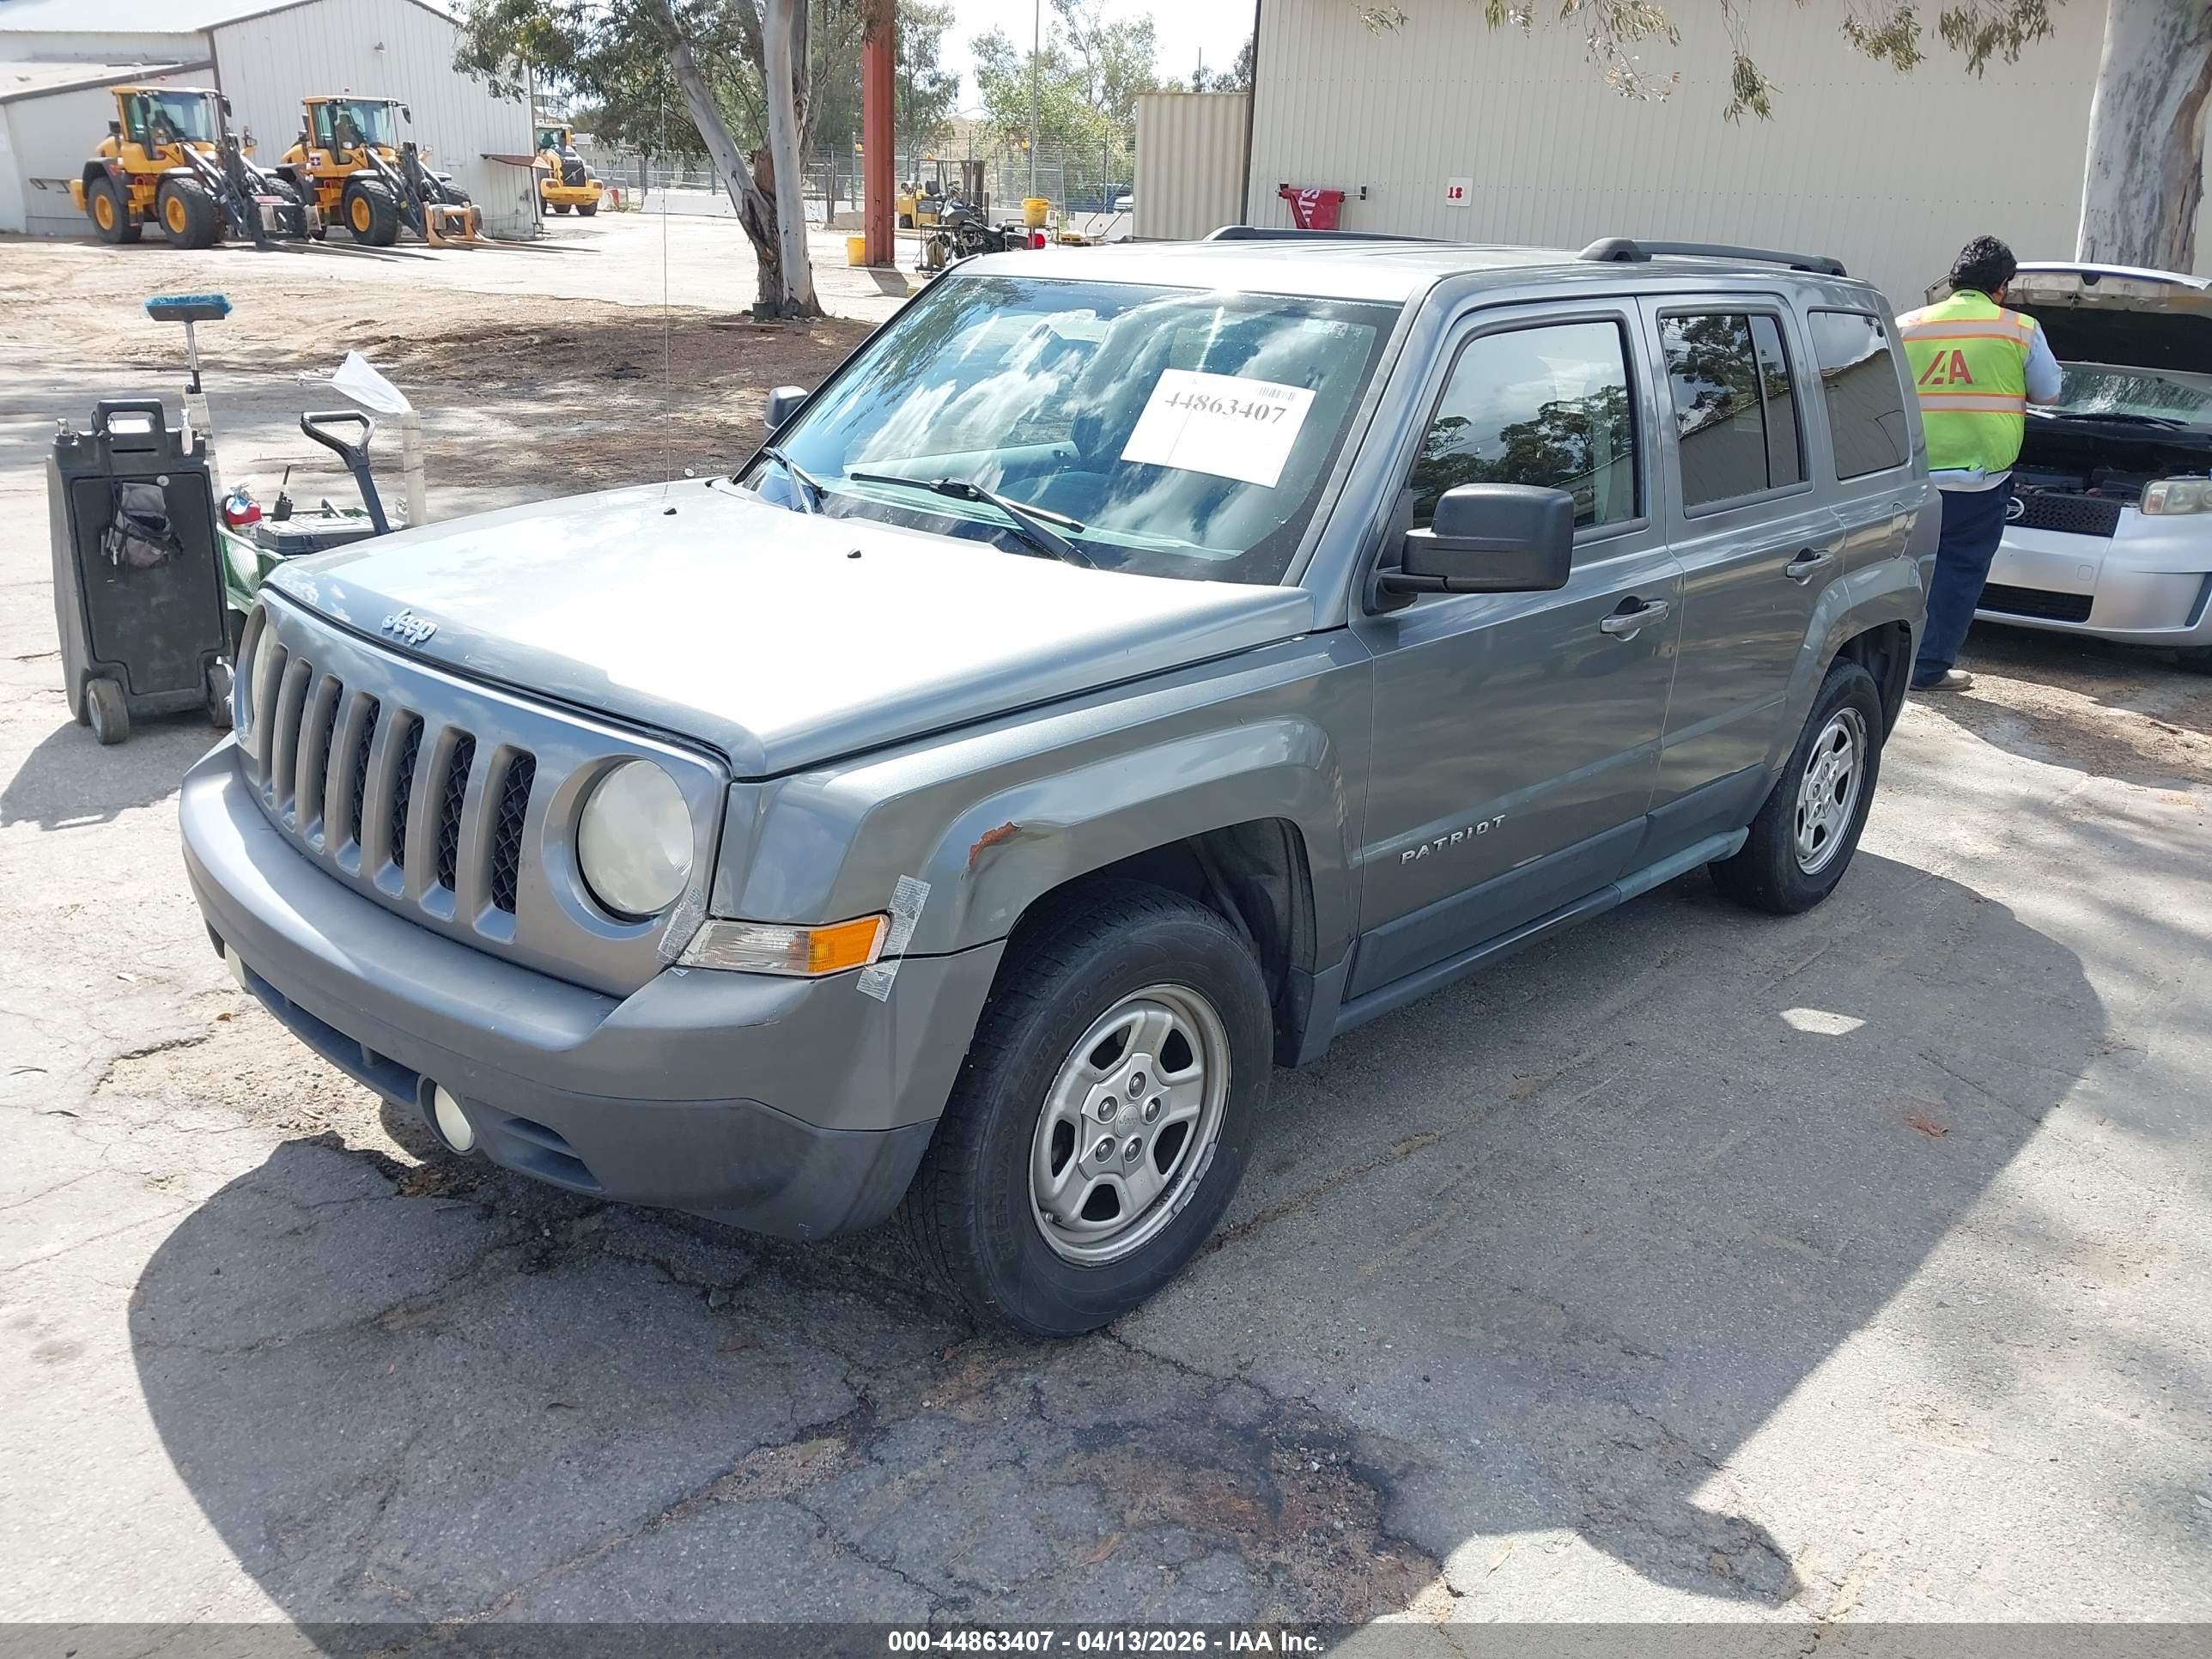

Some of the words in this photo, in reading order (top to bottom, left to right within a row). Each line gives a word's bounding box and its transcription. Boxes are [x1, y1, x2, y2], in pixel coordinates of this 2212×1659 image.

[1447, 186, 1463, 199] 18
[1164, 391, 1287, 424] 44863407
[381, 607, 438, 645] Jeep
[1401, 814, 1506, 866] PATRIOT
